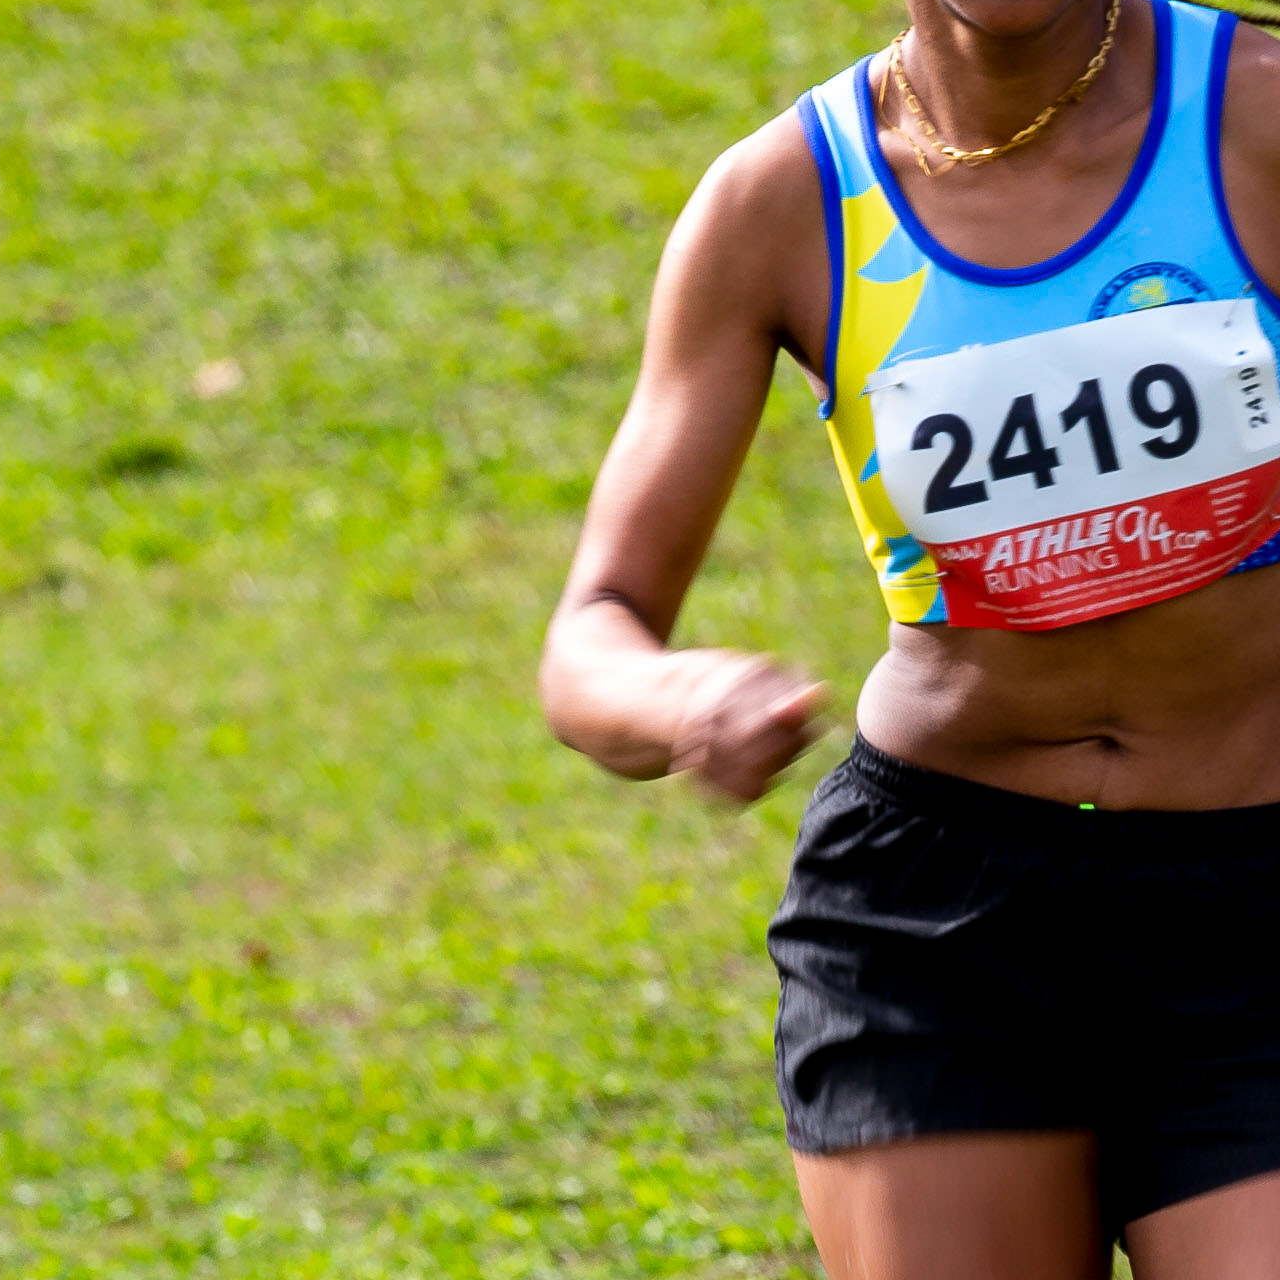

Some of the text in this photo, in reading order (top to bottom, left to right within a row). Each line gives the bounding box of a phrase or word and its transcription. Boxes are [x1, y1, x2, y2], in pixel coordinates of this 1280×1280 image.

[910, 362, 1201, 514] 2419
[983, 511, 1116, 571] ATHLE
[984, 545, 1120, 595] RUNNING
